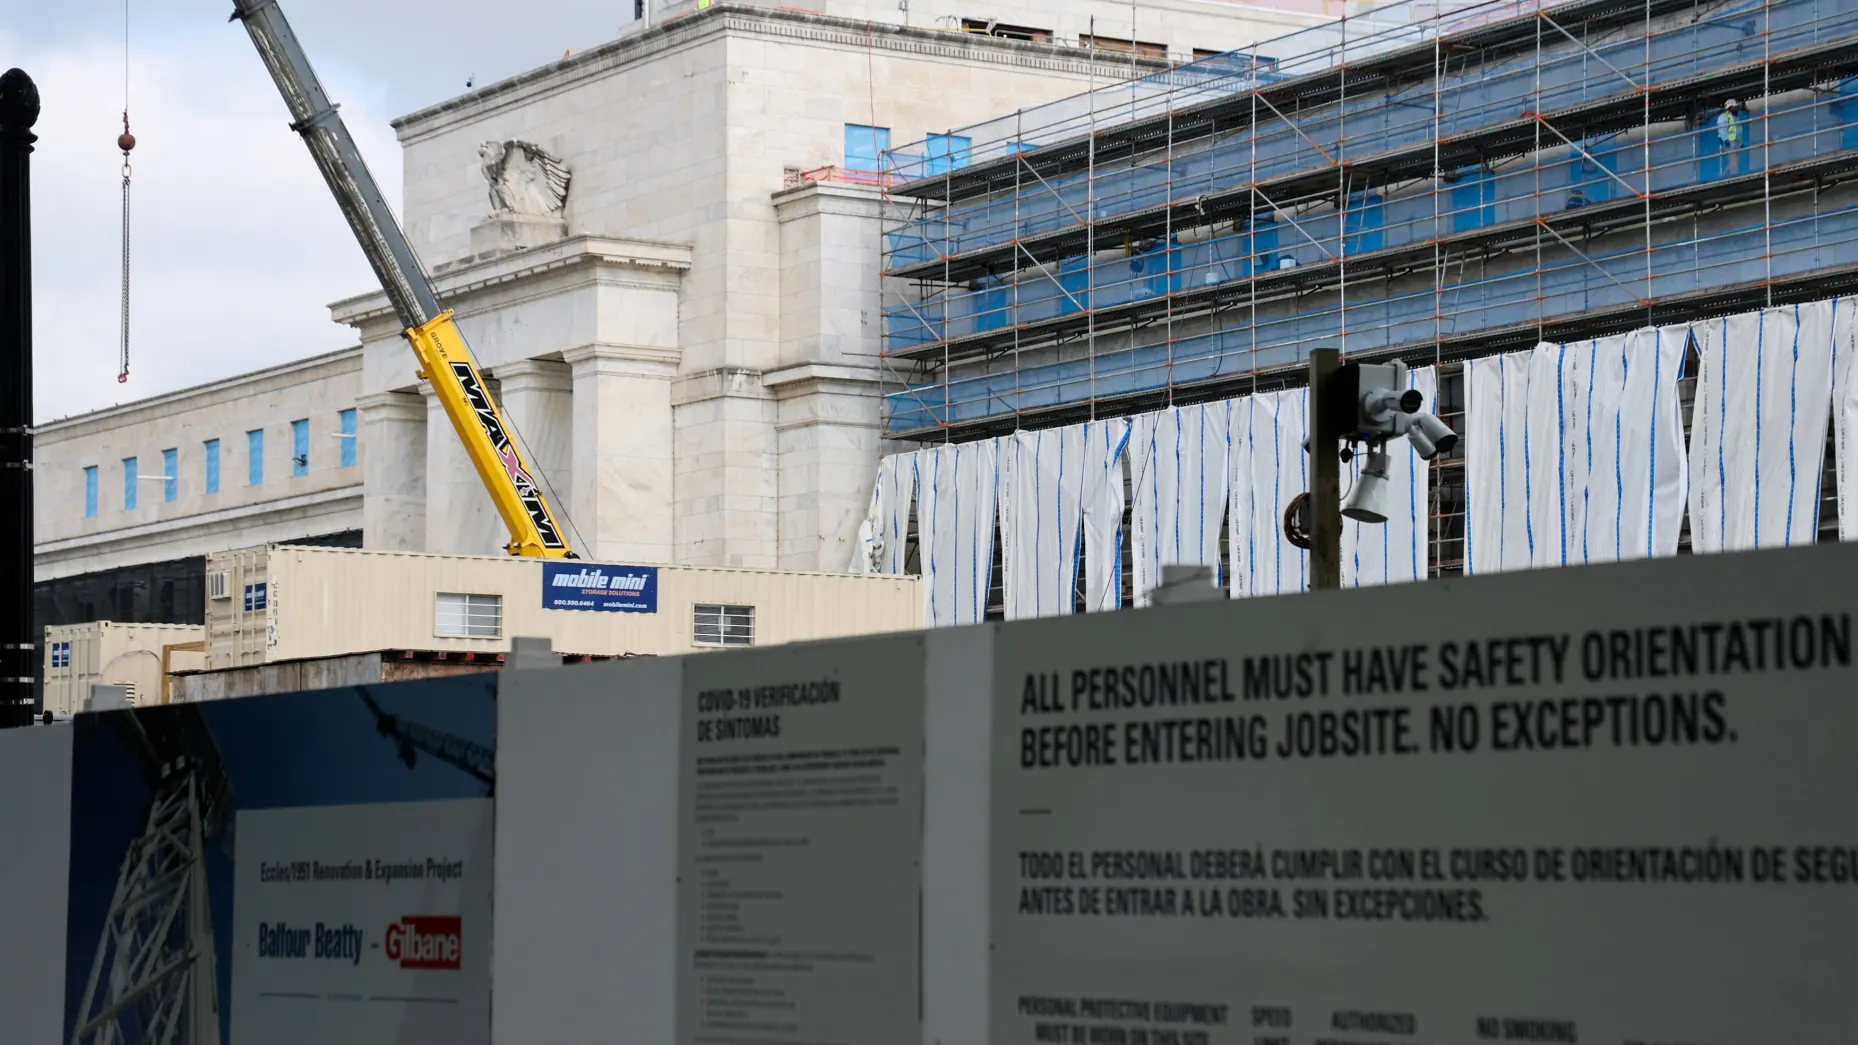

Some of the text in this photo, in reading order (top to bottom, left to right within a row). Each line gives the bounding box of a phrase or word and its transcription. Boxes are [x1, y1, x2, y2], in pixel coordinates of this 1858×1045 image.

[430, 331, 448, 359] GROVE
[449, 362, 565, 548] MAXIM
[552, 569, 648, 590] mobile mini
[1021, 613, 1851, 714] ALL PERSONNEL MUST HAVE SAFETY ORIENTATION
[697, 677, 841, 712] COVID-19 VERIFICACIÓN
[697, 719, 713, 742] DE
[1021, 690, 1738, 768] BEFORE ENTERING JOBSITE. NO EXCEPTIONS.
[312, 861, 362, 881] Renovation
[365, 859, 372, 879] &
[375, 858, 424, 885] Expansion
[426, 857, 463, 883] Project
[1018, 850, 1064, 879] TODO
[1068, 850, 1088, 879] EL
[1092, 850, 1187, 880] PERSONAL
[1191, 843, 1267, 881] DEBERÁ
[1271, 849, 1364, 881] CUMPLIR
[1368, 848, 1414, 881] CON
[1421, 848, 1445, 882] EL
[1450, 848, 1529, 882] CURSO
[1533, 848, 1566, 882] DE
[1571, 838, 1744, 883] ORIENTACIÓN
[1752, 847, 1787, 883] DE
[1018, 887, 1075, 915] ANTES
[1079, 887, 1101, 916] DE
[1105, 887, 1177, 917] ENTRAR
[1180, 888, 1196, 917] A
[1200, 887, 1224, 917] LA
[1292, 888, 1329, 919] SIN
[1333, 888, 1489, 922] EXCEPCIONES.
[258, 921, 310, 958] Balfour
[315, 922, 363, 966] Beatty
[385, 922, 459, 962] Gilbane
